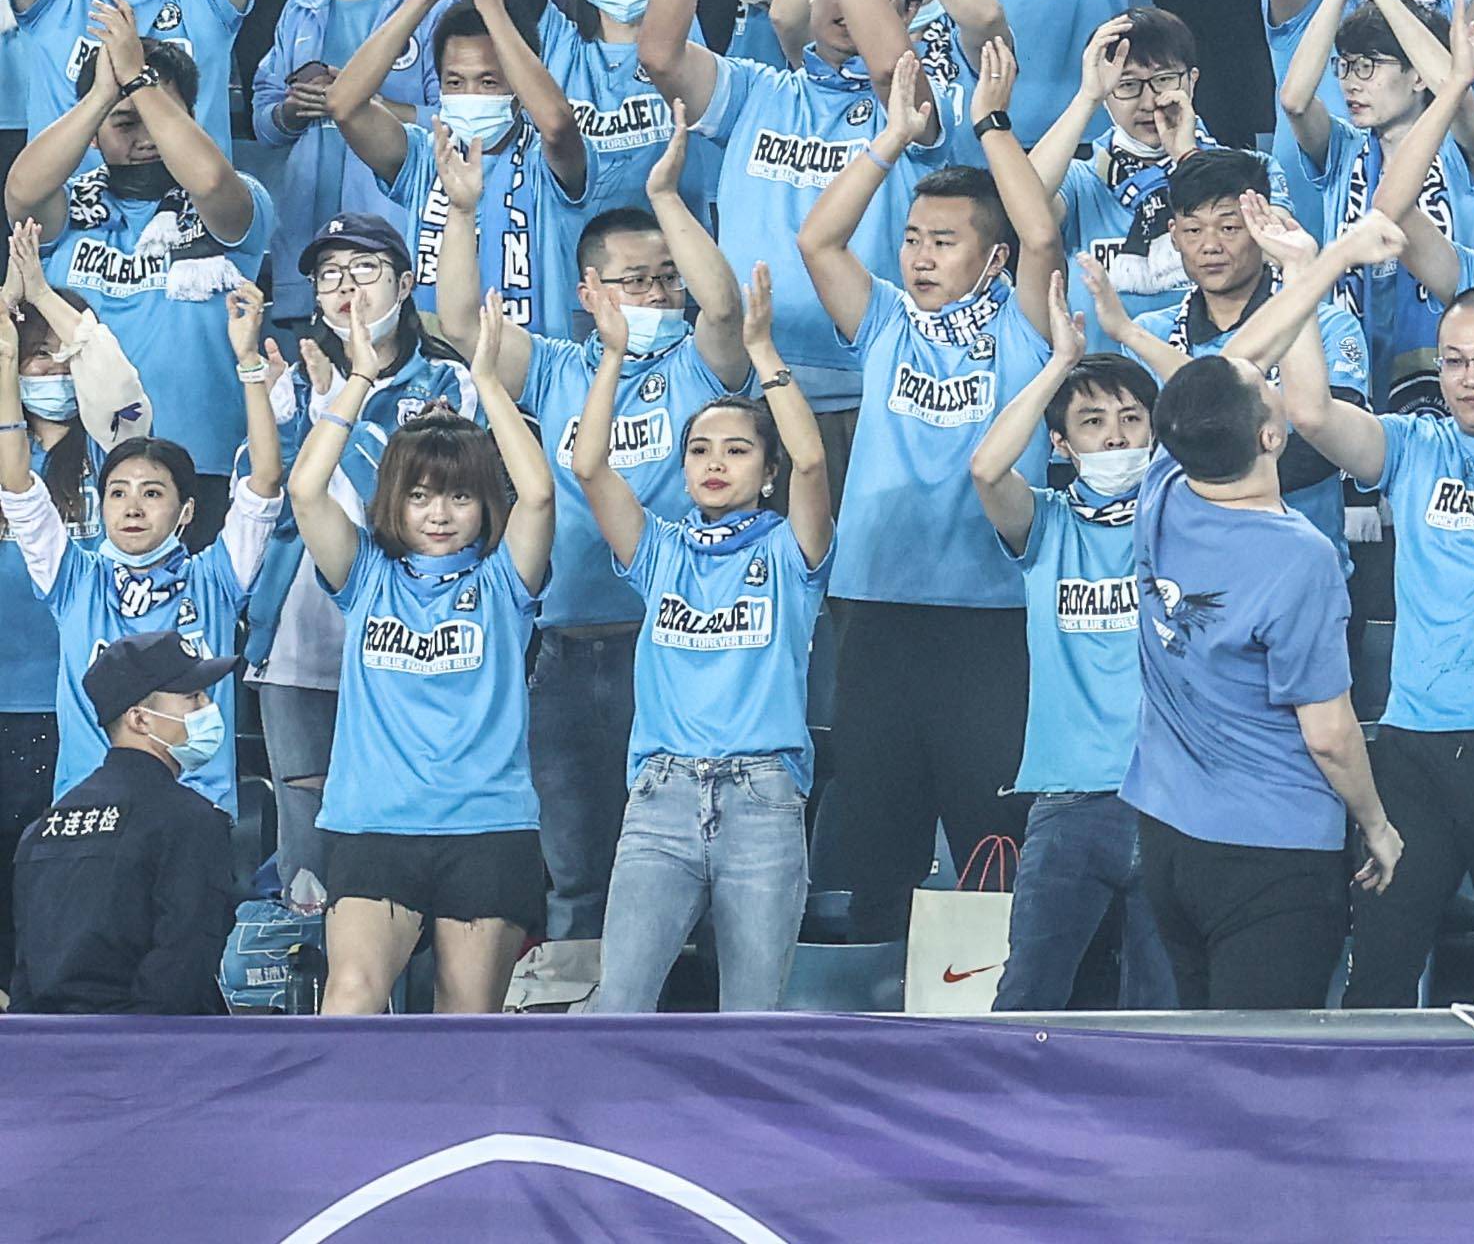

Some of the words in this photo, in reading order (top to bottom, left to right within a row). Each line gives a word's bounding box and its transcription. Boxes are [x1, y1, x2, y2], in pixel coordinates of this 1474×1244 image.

[573, 99, 669, 137] YALBLUE17
[656, 597, 767, 636] ROYALBLUE17
[366, 619, 475, 662] ROYALBLUE17
[455, 656, 481, 669] BLUE
[41, 806, 120, 838] 大连安检
